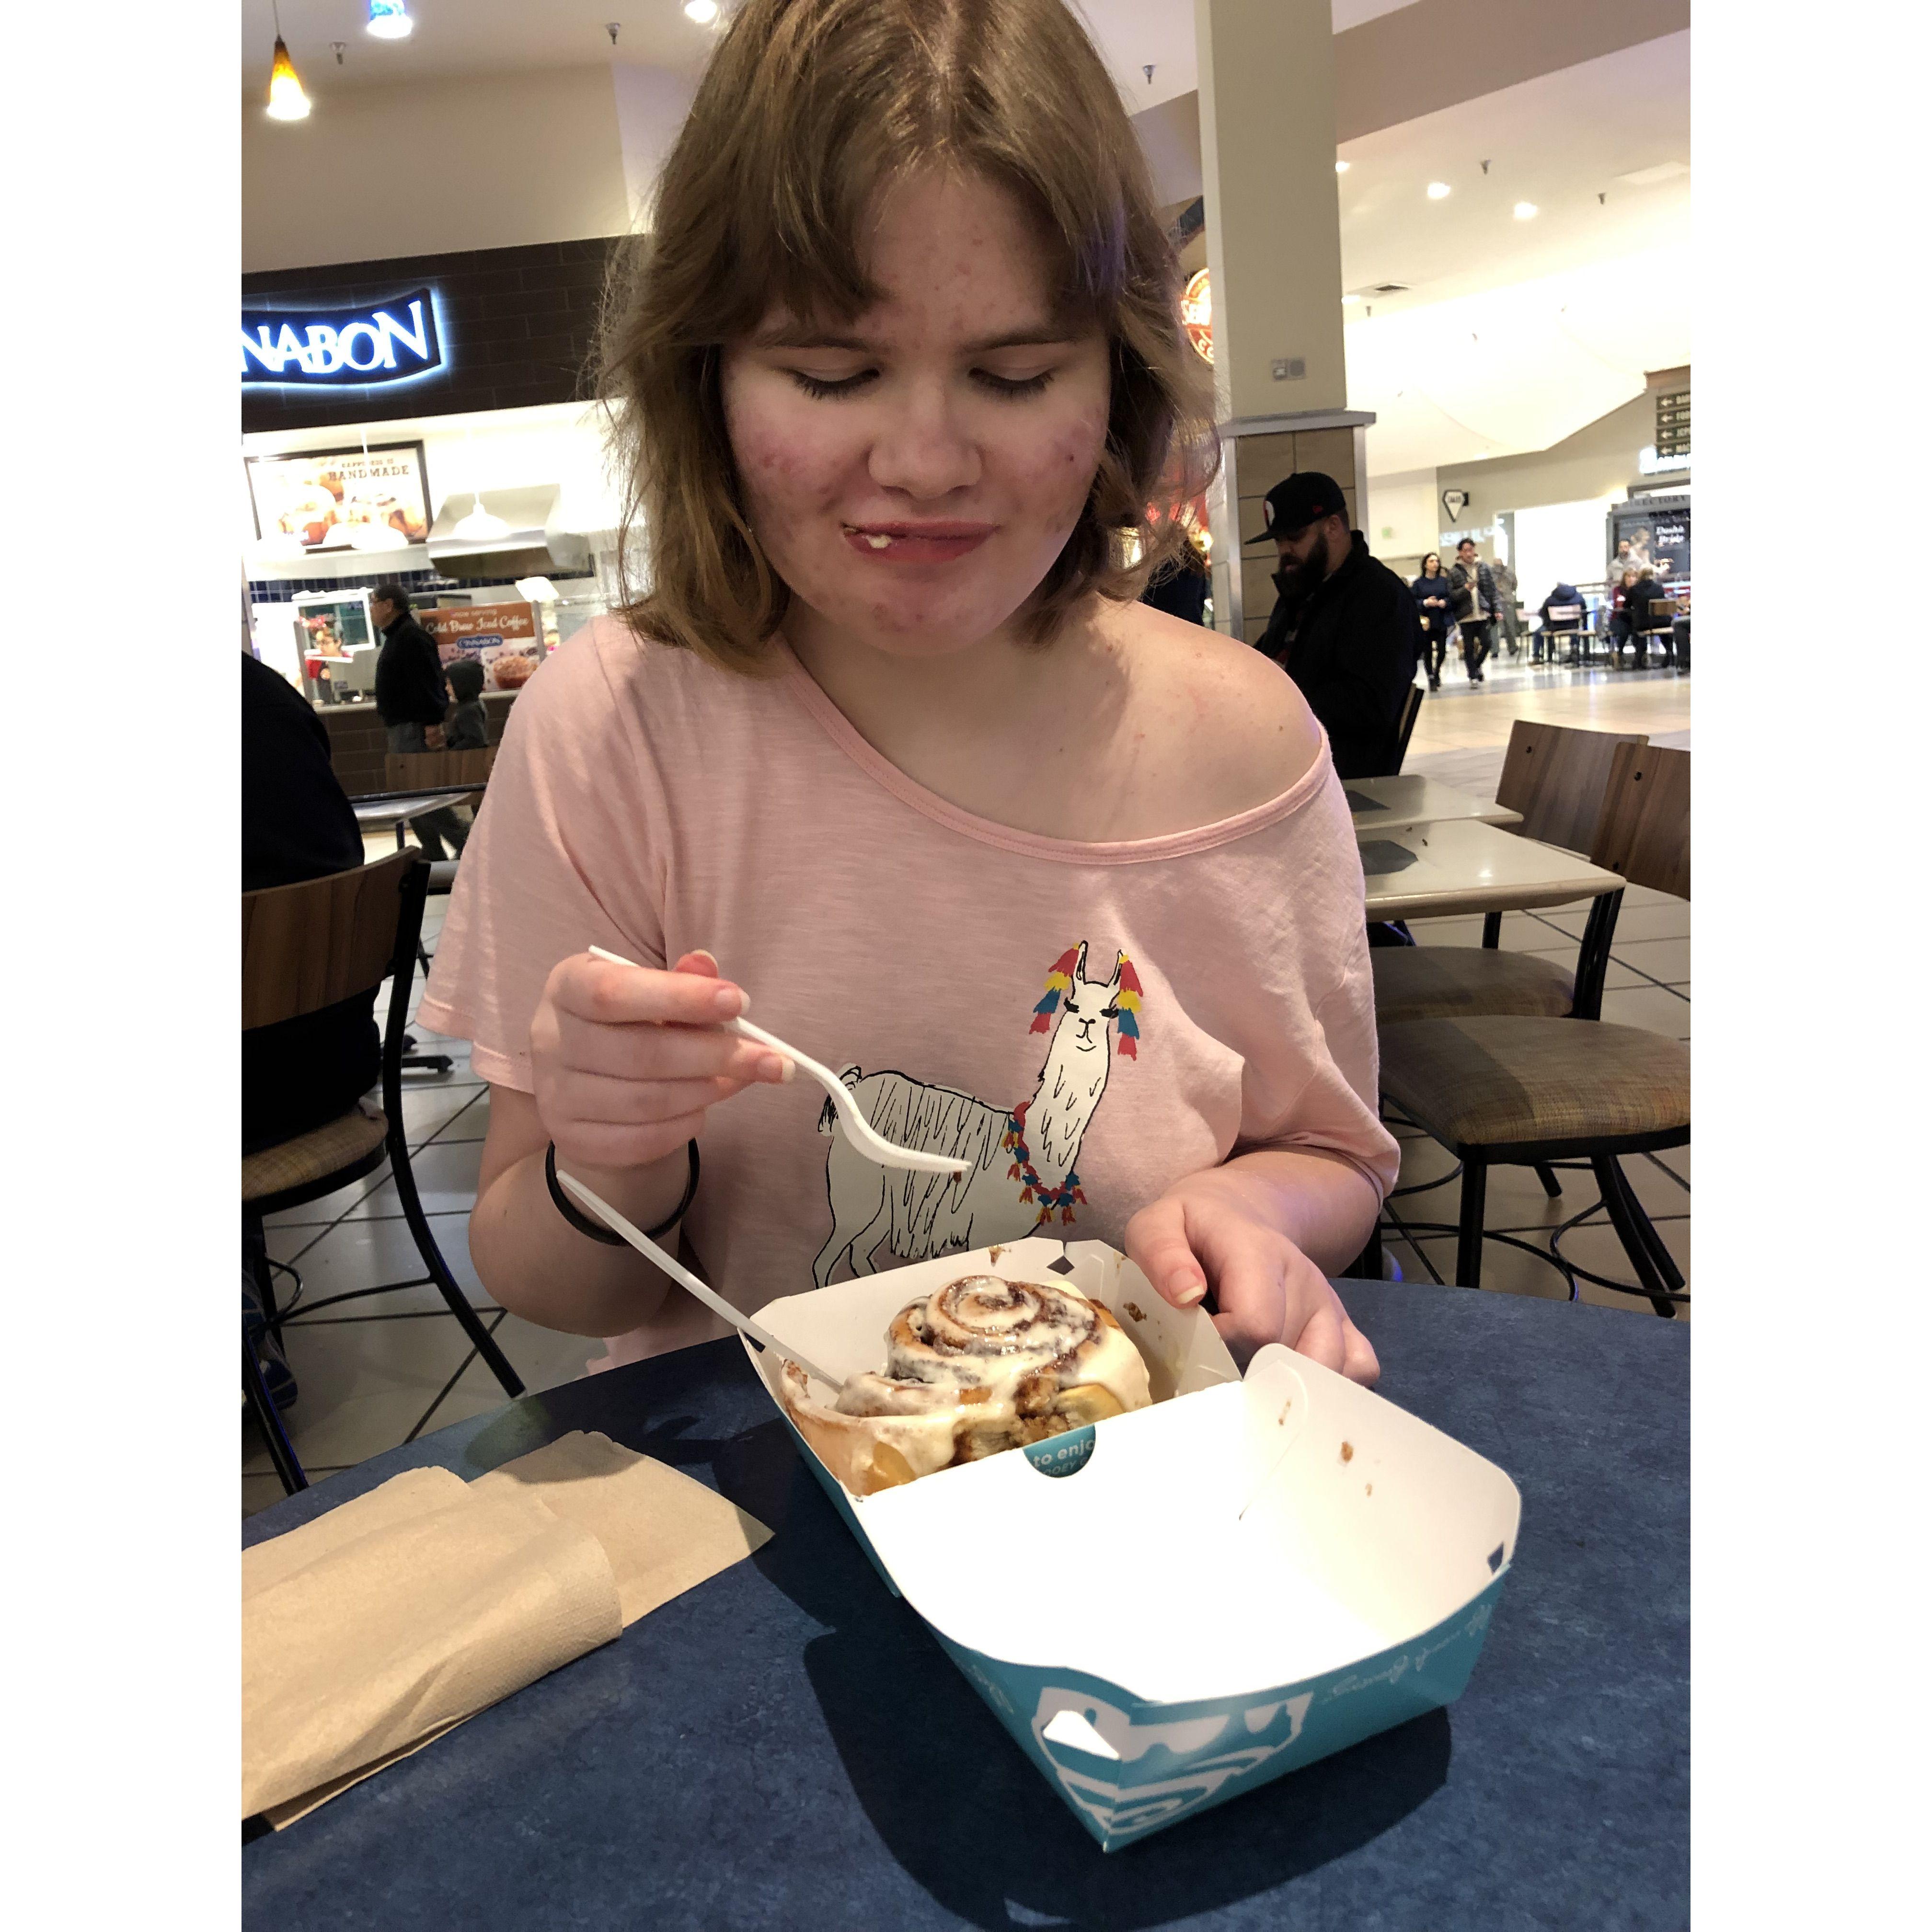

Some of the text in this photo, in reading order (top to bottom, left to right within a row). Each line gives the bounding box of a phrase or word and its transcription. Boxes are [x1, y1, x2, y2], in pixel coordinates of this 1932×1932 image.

[327, 465, 409, 481] HANDMADE
[426, 621, 448, 635] Cold
[499, 615, 529, 632] Coffee
[1033, 1453, 1052, 1468] to
